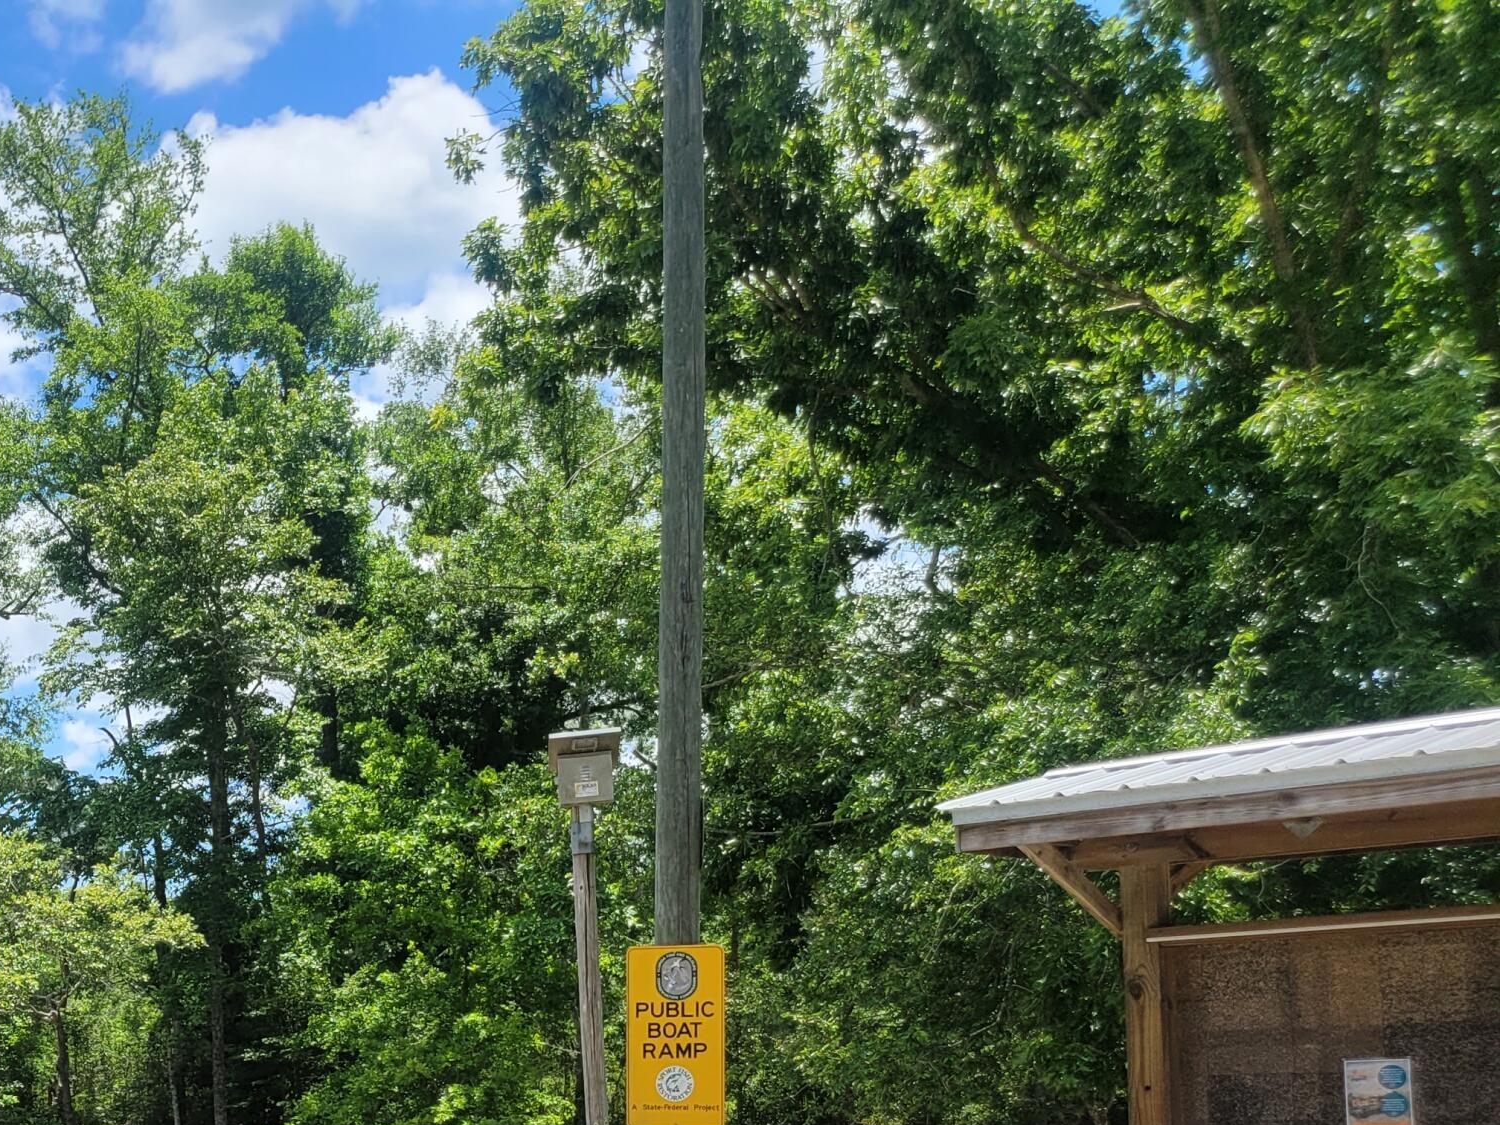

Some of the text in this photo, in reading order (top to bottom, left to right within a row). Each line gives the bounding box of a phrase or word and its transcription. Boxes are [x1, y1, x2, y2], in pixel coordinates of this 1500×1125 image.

[636, 1001, 714, 1018] PUBLIC
[648, 1022, 702, 1038] BOAT
[643, 1043, 707, 1059] RAMP
[694, 1104, 720, 1112] Project
